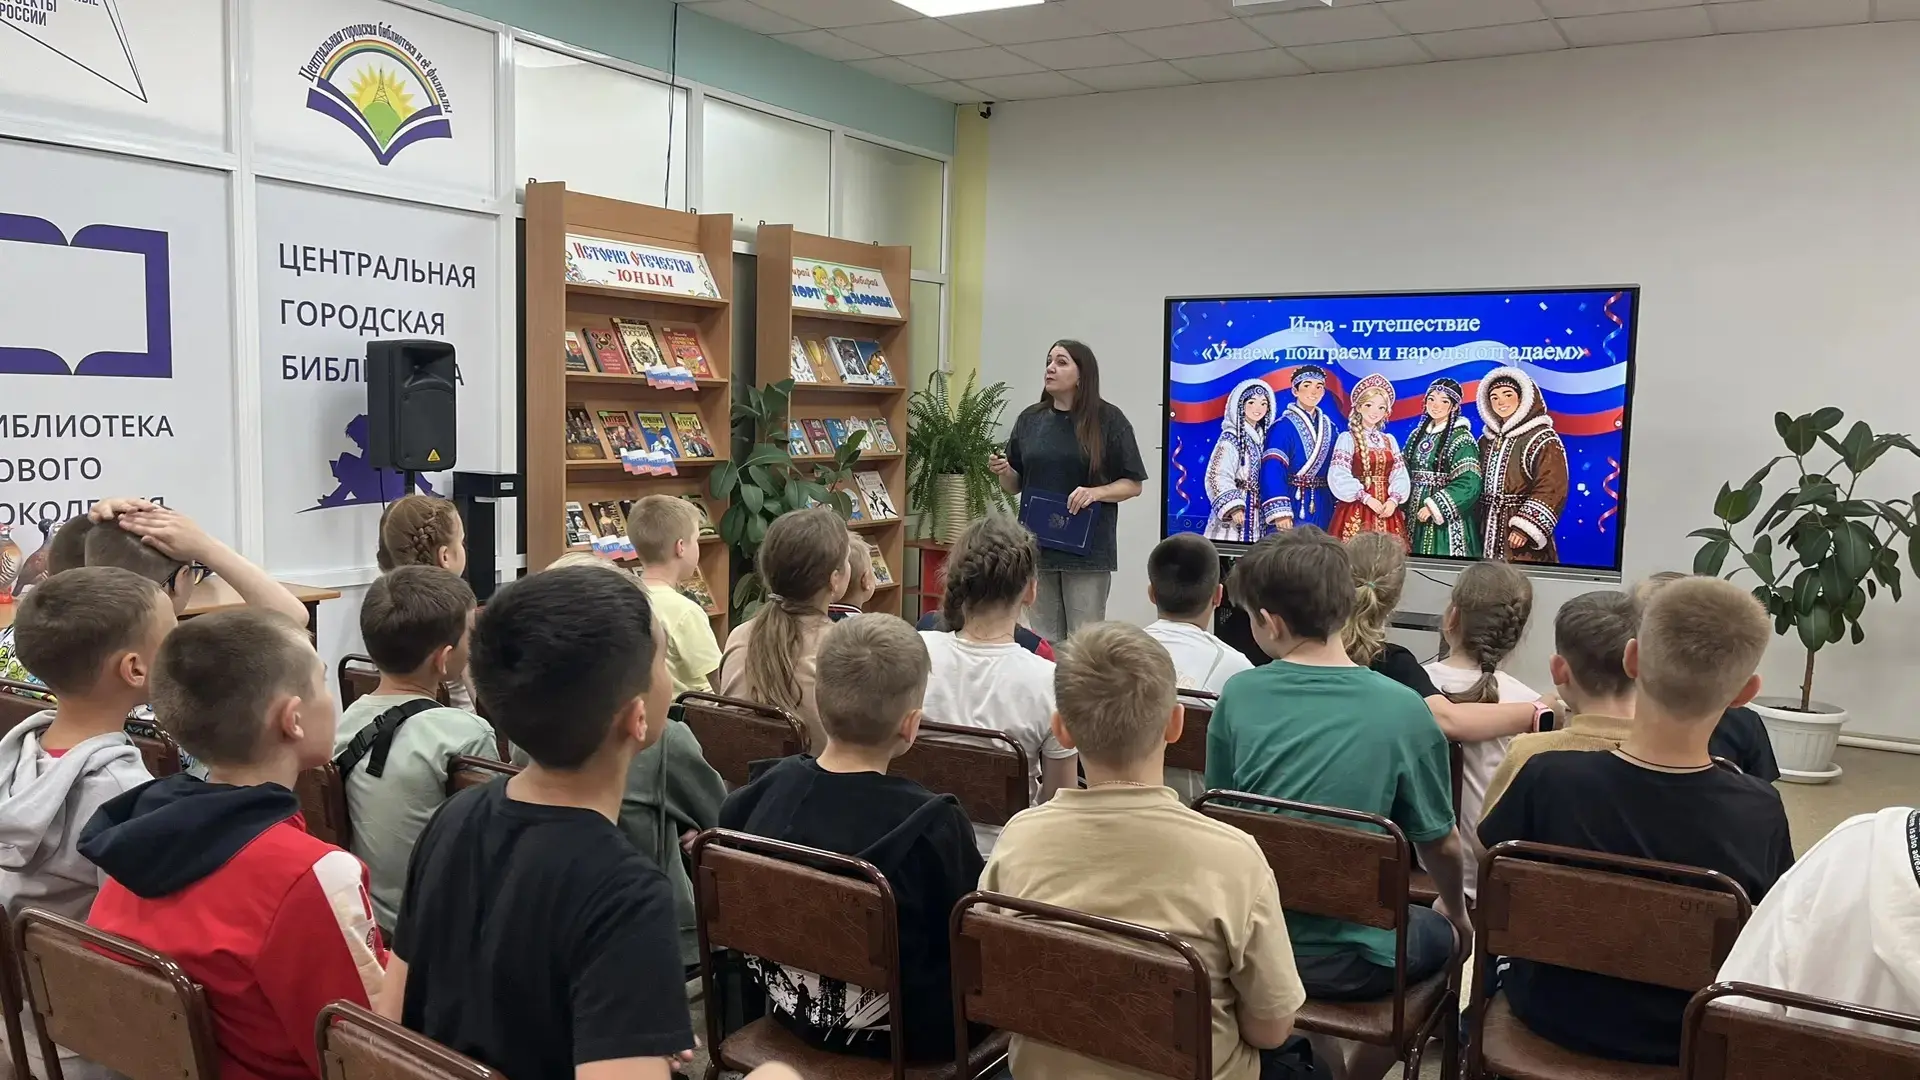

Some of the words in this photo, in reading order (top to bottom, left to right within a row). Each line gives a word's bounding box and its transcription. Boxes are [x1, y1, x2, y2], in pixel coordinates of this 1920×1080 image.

[0, 2, 46, 26] РОССИИ
[298, 31, 345, 83] Центральная
[342, 23, 377, 42] городская
[378, 21, 417, 56] библиотека
[427, 68, 453, 114] филиалы
[279, 243, 476, 289] ЦЕНТРАЛЬНАЯ
[281, 299, 445, 337] ГОРОДСКАЯ
[1289, 316, 1335, 337] Игра
[1352, 318, 1481, 337] путешествие
[1202, 343, 1280, 363] «Узнаем,
[1285, 346, 1373, 364] поиграем
[1378, 347, 1391, 360] и
[1395, 346, 1469, 365] народы
[0, 457, 102, 482] ОВОГО
